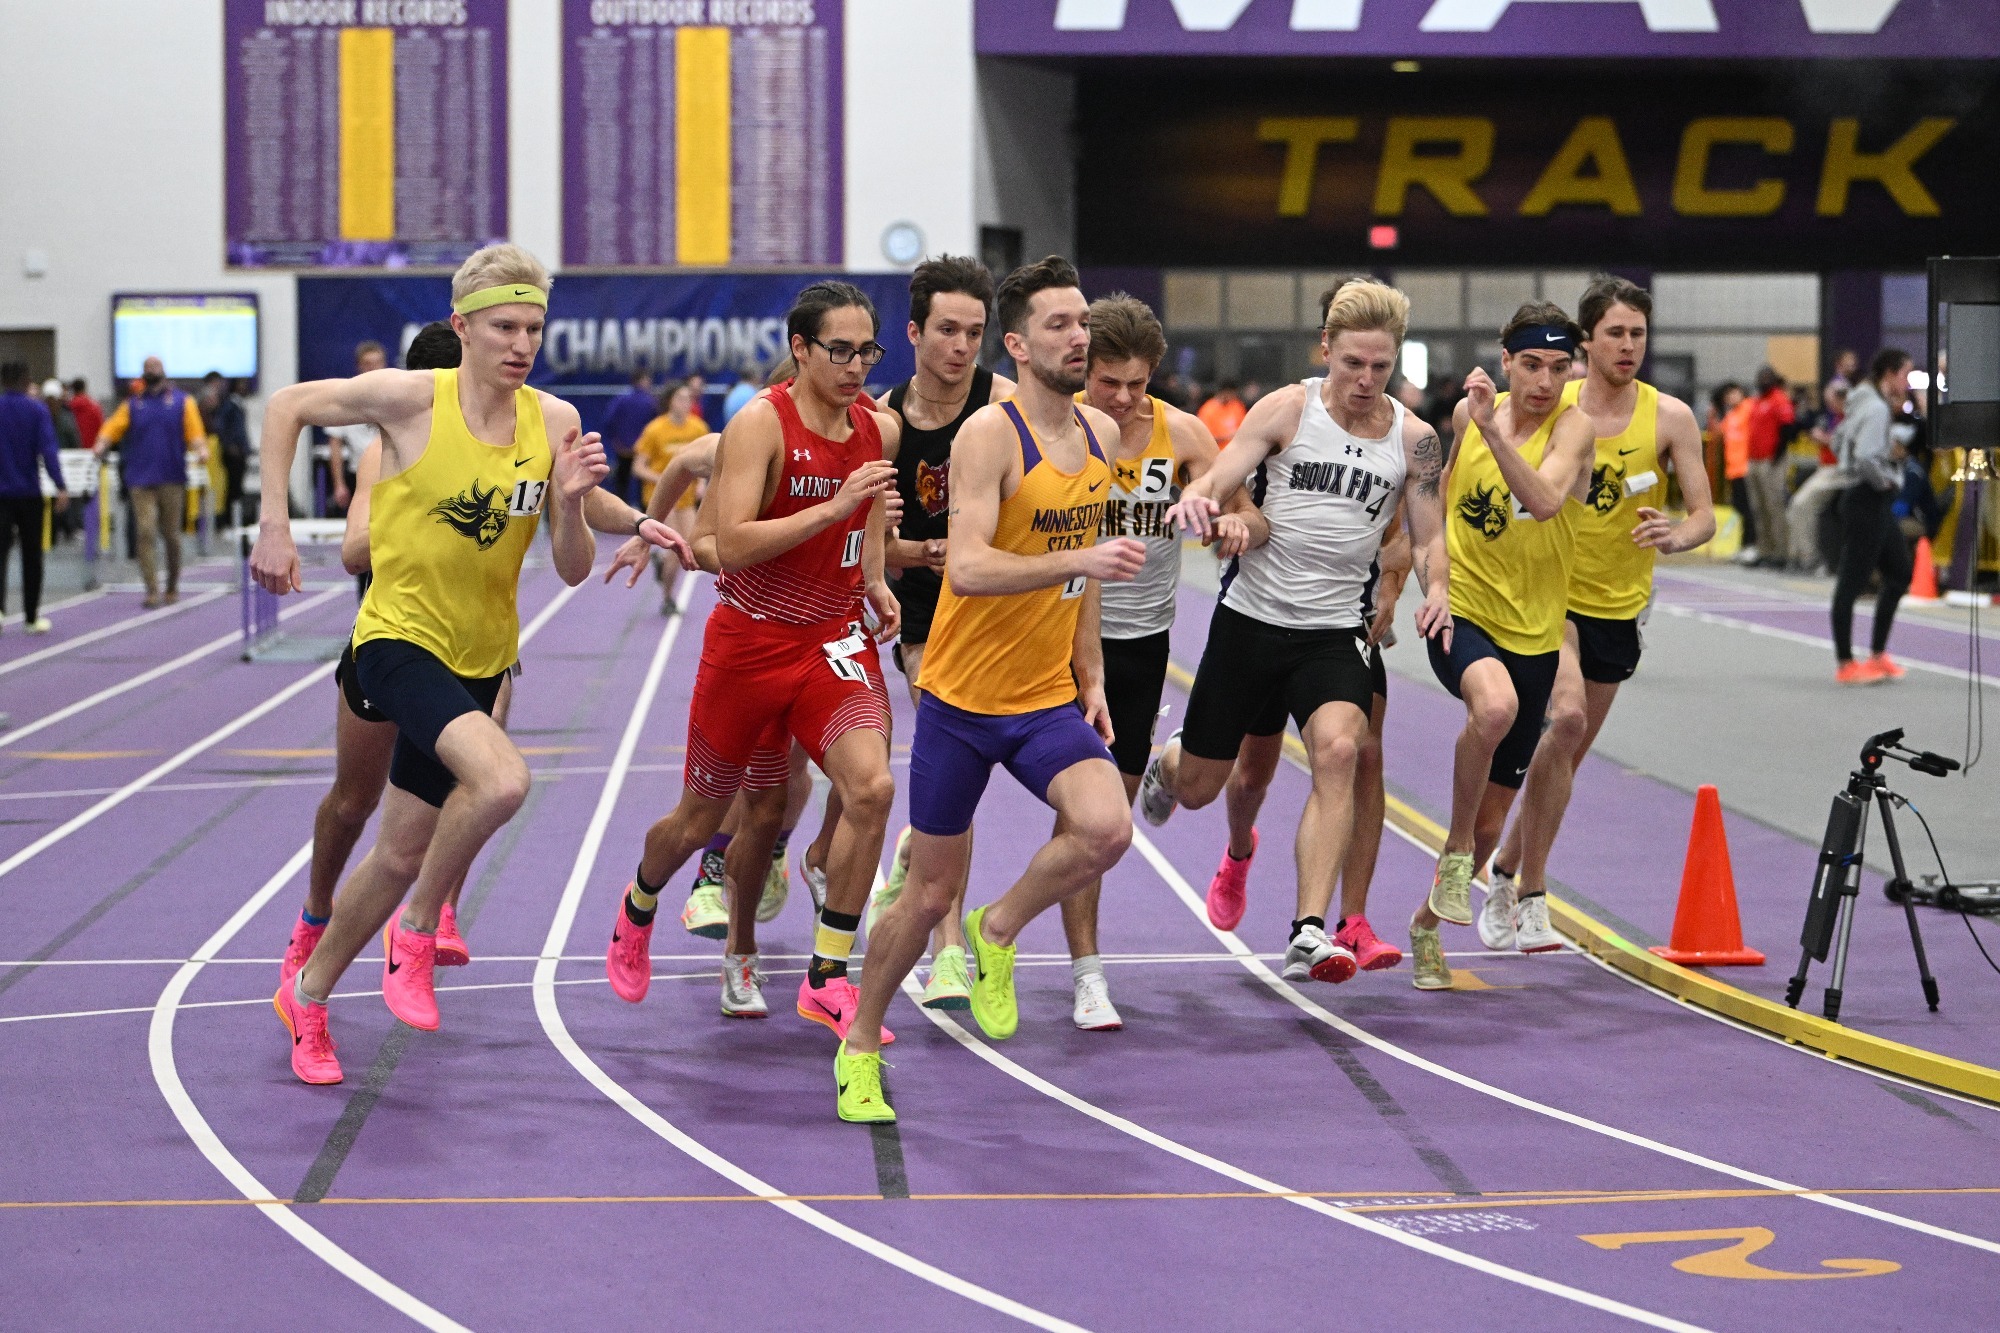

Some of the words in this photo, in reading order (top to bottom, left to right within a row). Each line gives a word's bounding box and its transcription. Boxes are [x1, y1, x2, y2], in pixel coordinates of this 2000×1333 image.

[362, 0, 468, 25] RECORDS
[590, 0, 705, 25] OUTDOOR
[709, 0, 816, 25] RECORDS
[1257, 116, 1958, 217] TRACK
[789, 476, 842, 498] MINOT
[1145, 458, 1168, 493] 5
[1289, 462, 1347, 495] SIOUX
[513, 480, 545, 511] 13
[1365, 492, 1390, 521] 4
[1031, 501, 1104, 533] MINNESOTA
[1098, 500, 1127, 537] NE
